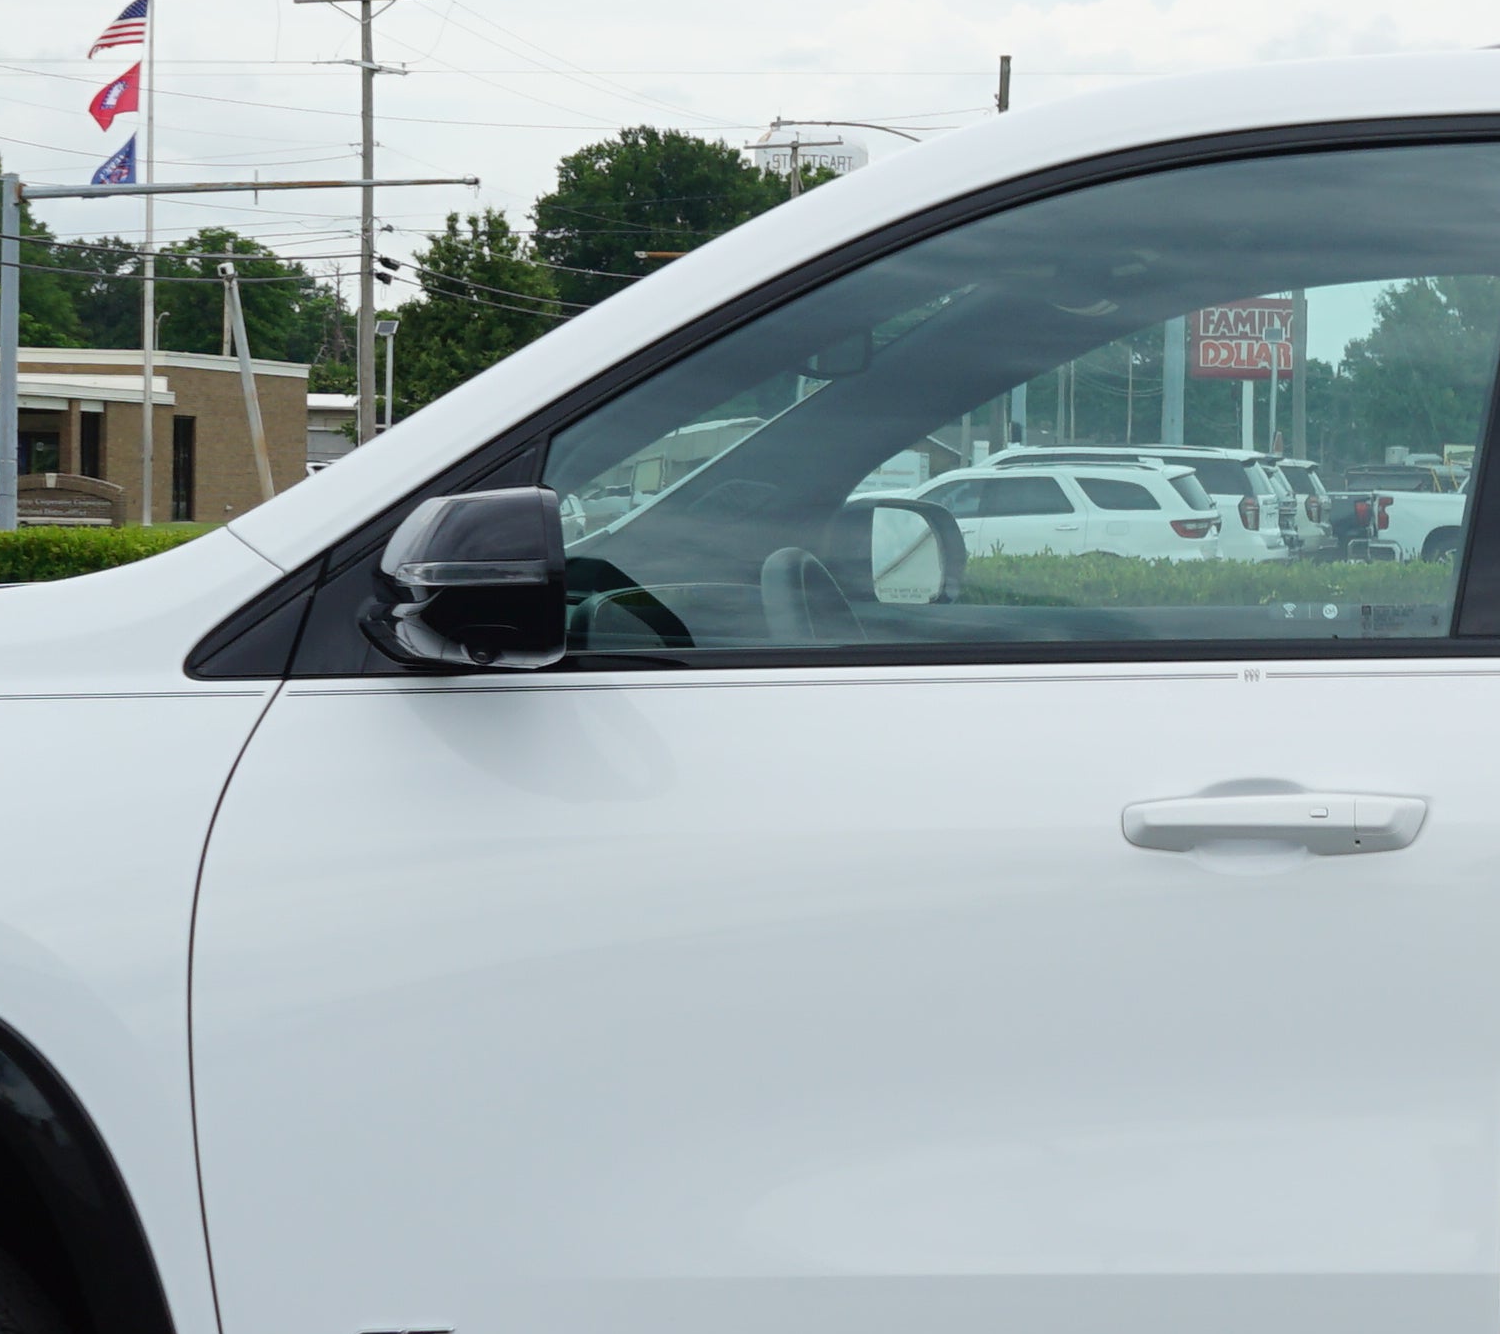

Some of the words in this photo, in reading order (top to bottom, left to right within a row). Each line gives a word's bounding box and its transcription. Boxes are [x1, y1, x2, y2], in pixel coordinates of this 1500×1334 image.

[772, 154, 853, 171] STTTGART
[1199, 307, 1293, 338] FAMILY
[1199, 339, 1293, 370] DOLLAR
